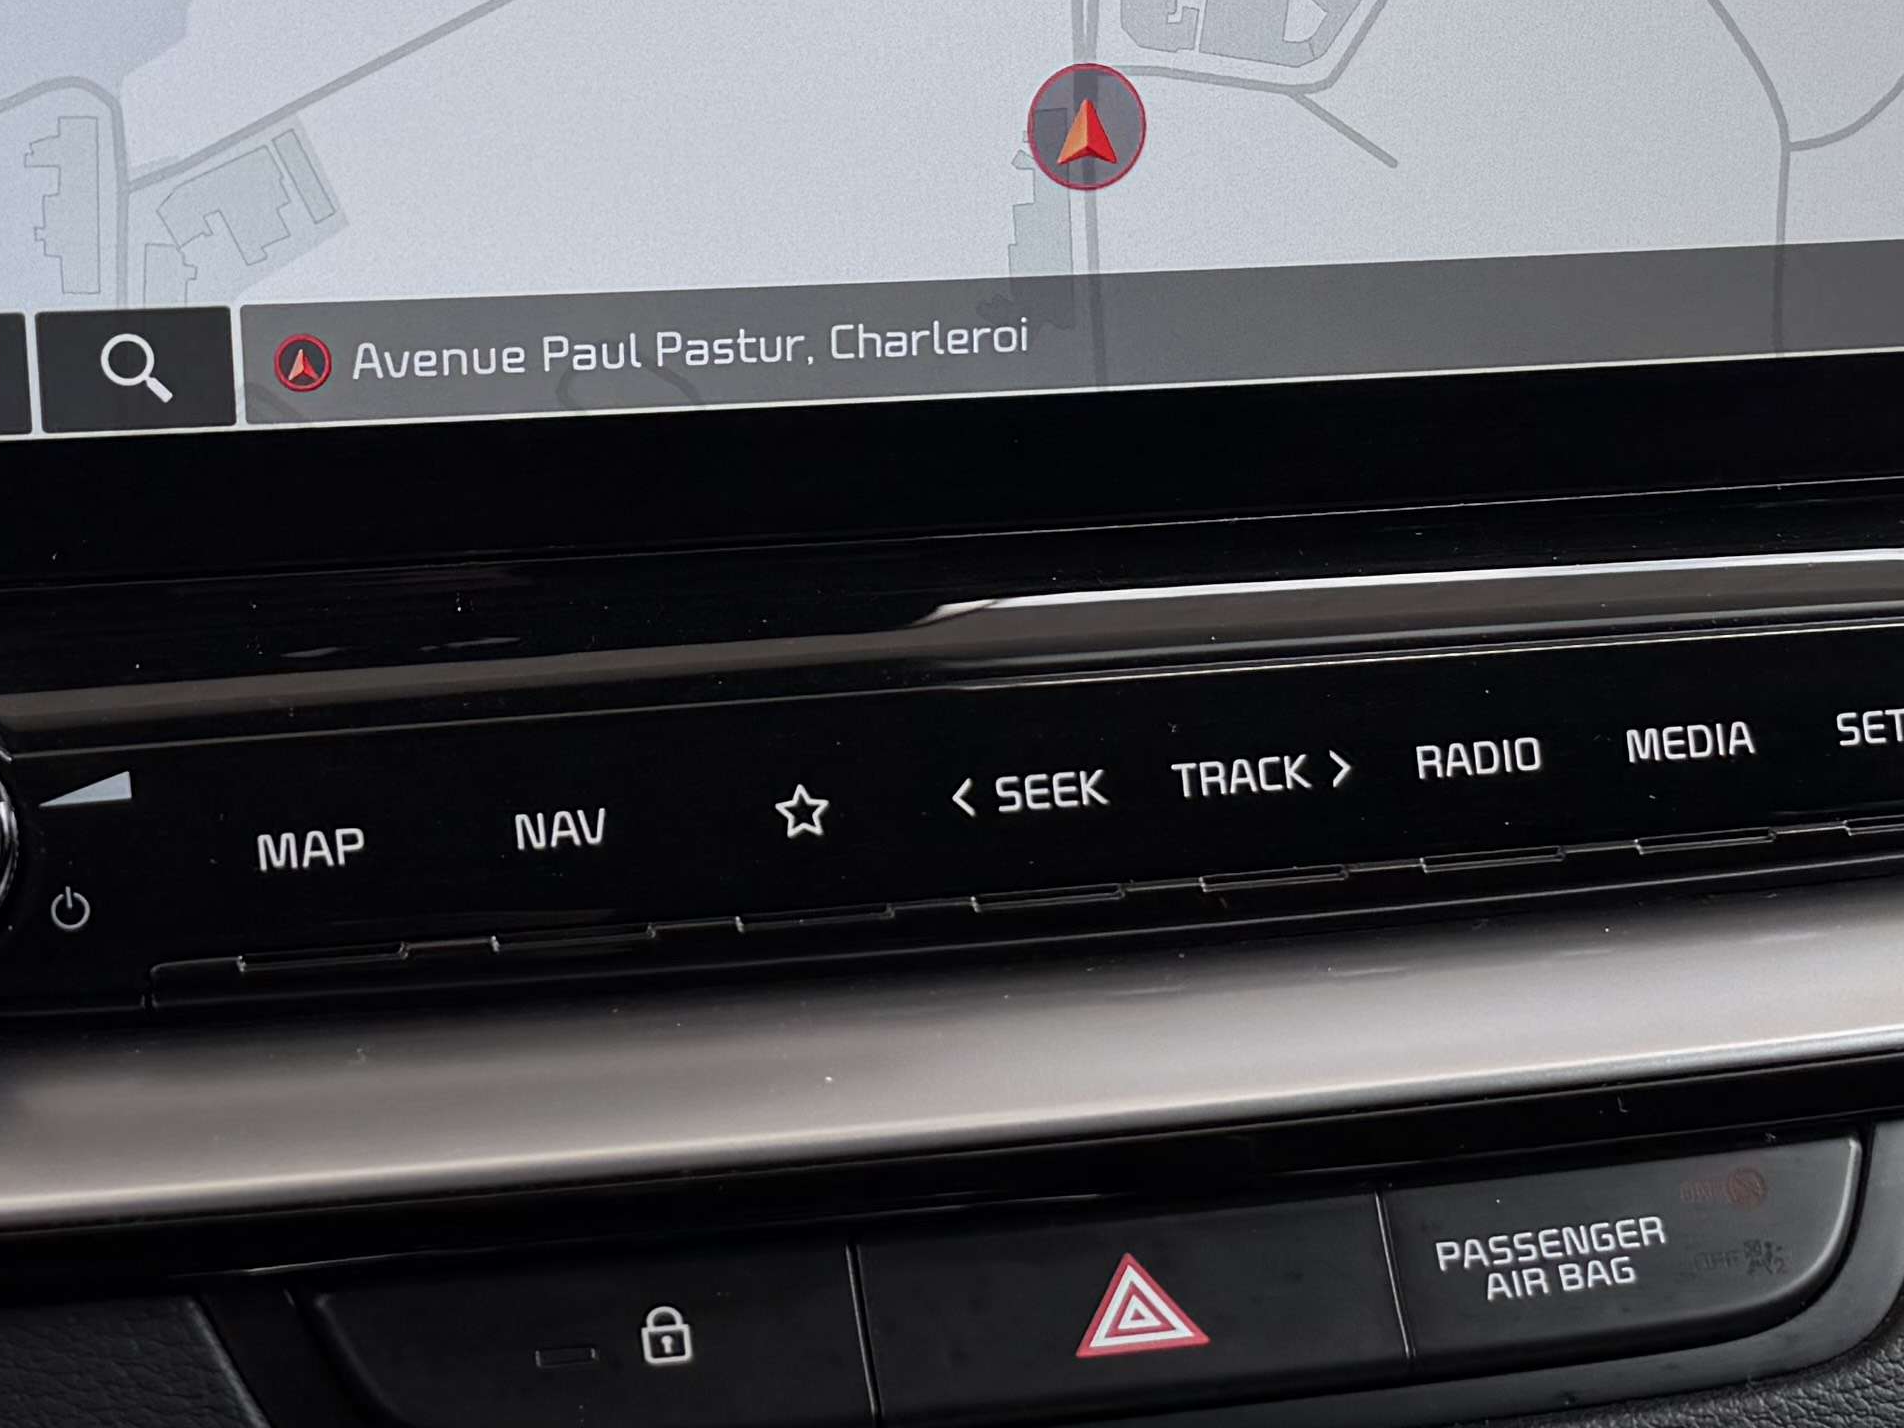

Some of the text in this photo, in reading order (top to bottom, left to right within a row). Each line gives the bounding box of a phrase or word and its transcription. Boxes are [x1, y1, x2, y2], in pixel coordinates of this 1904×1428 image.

[352, 316, 1030, 381] Avenue Paul Pastur, Charleroi
[1415, 736, 1543, 781] RADIO
[1625, 719, 1757, 765] MEDIA
[995, 768, 1108, 813] SEEK
[1171, 755, 1311, 799] TRACK
[255, 827, 365, 872] MAP
[513, 807, 607, 852] NAV
[1435, 1215, 1667, 1271] PASSENGER
[1486, 1265, 1551, 1302] AIR
[1559, 1256, 1638, 1293] BAG
